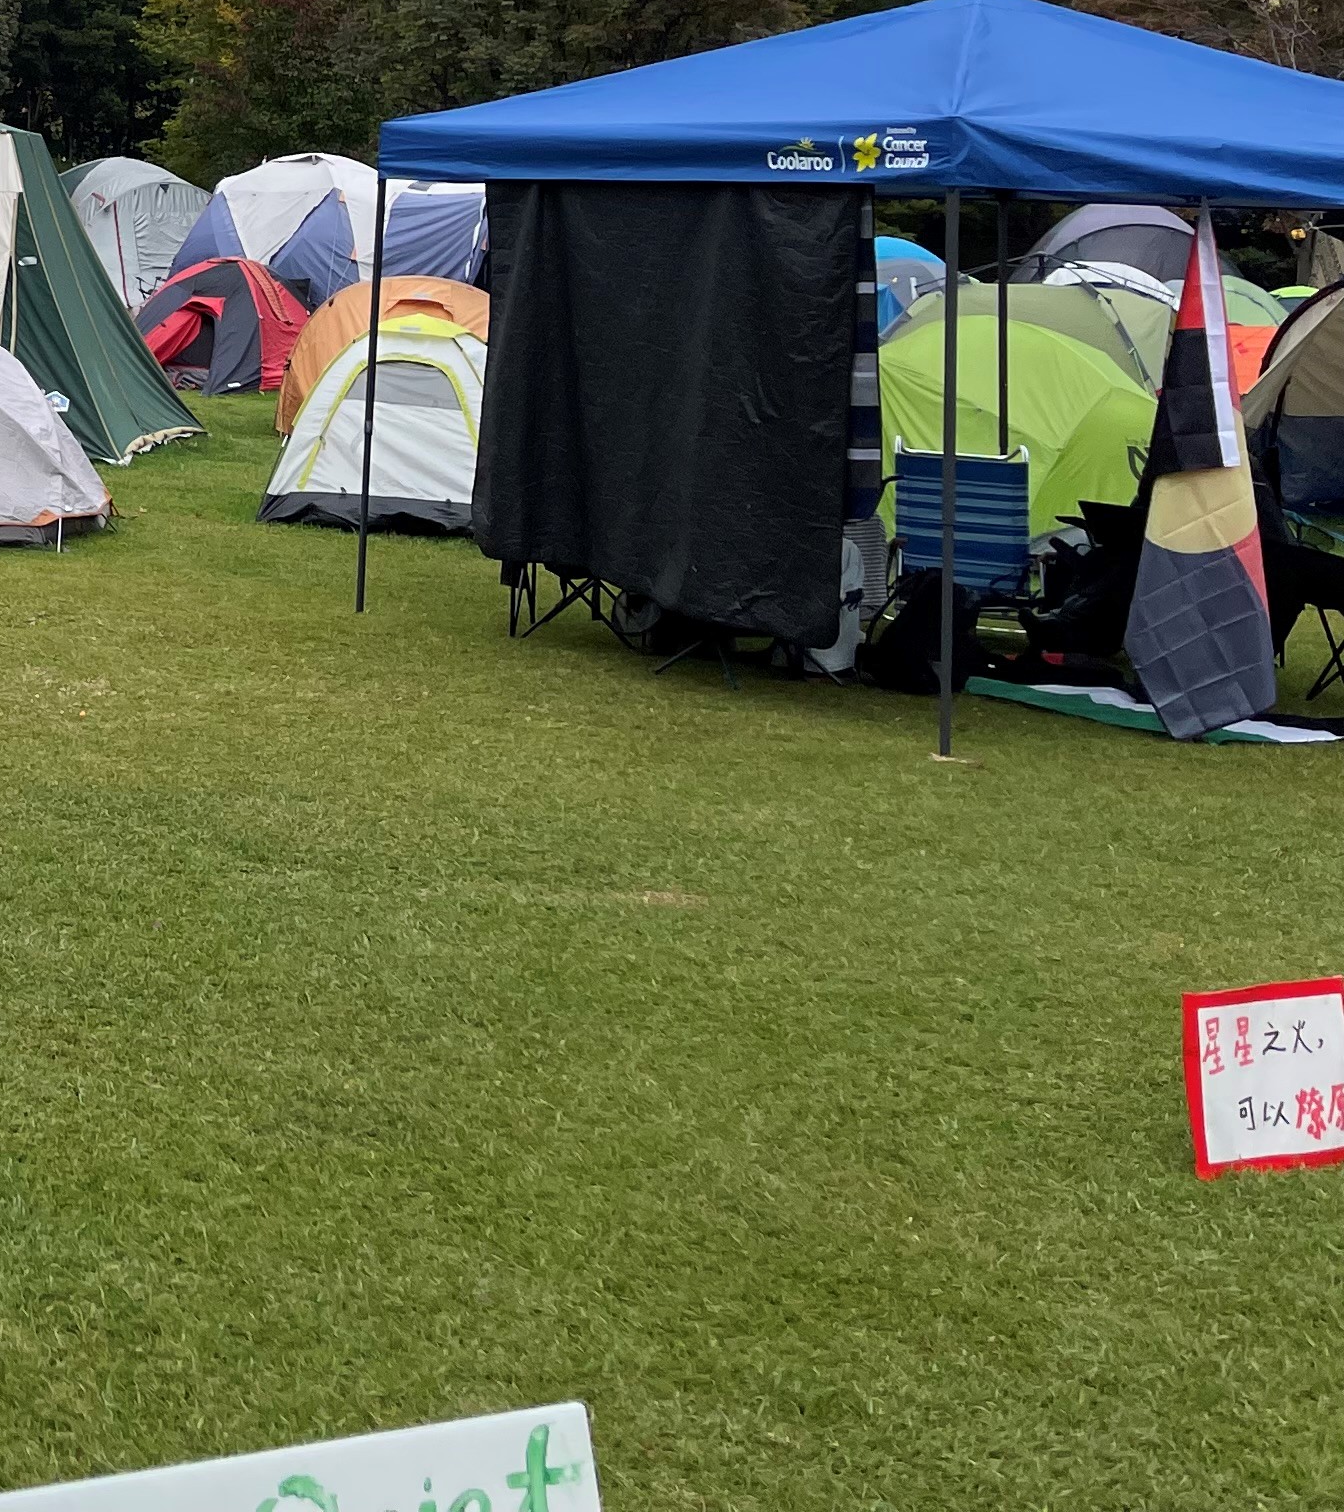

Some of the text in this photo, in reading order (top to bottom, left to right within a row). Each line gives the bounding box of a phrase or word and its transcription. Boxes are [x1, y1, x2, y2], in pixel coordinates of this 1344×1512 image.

[882, 136, 928, 152] Cancer
[767, 151, 833, 171] Coolaroo
[885, 153, 930, 169] Council
